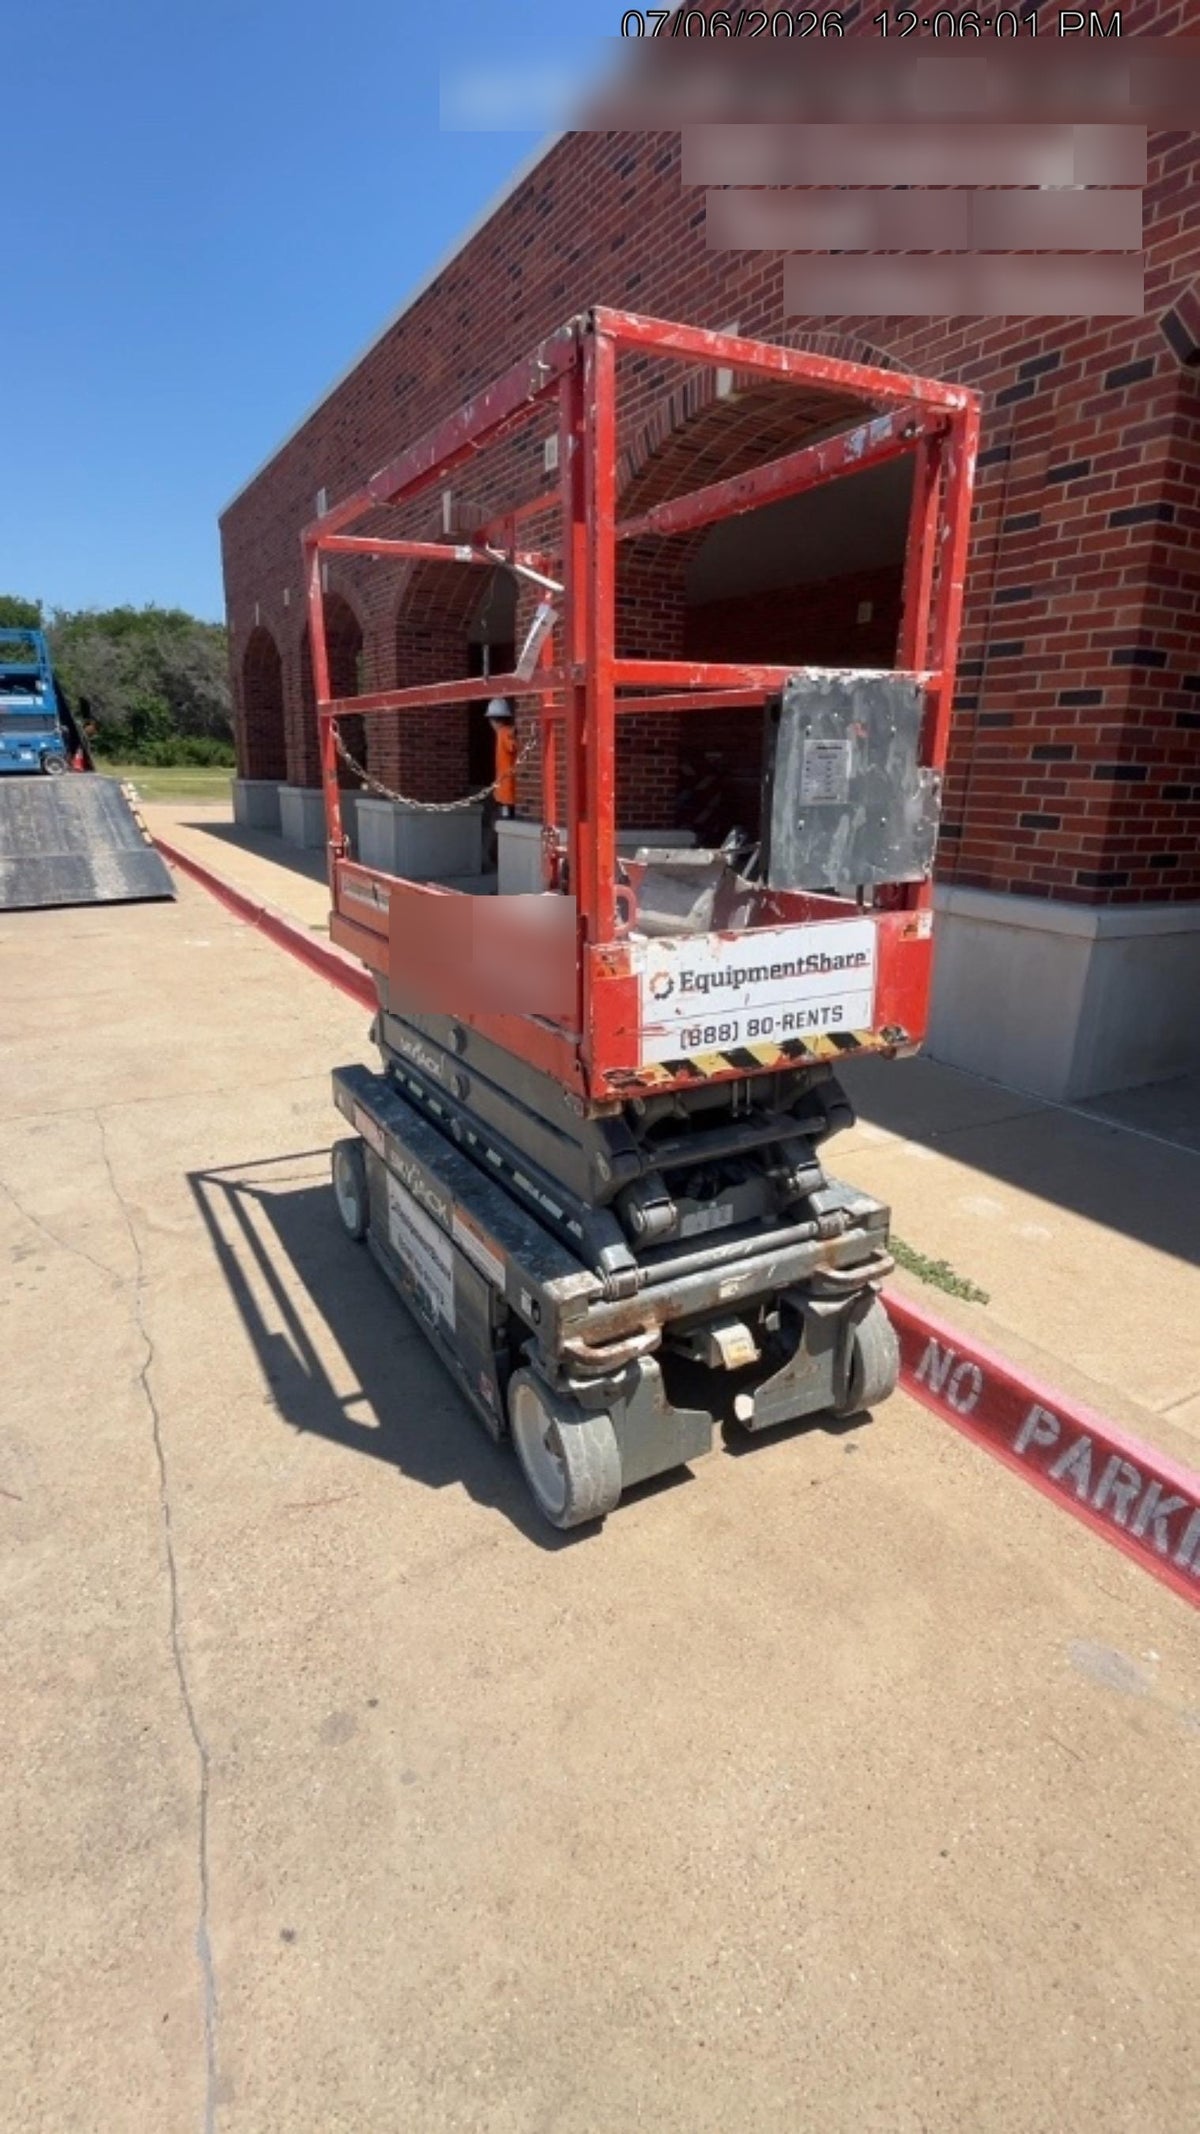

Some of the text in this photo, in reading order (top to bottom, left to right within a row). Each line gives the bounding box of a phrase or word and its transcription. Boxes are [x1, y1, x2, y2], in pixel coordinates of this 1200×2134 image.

[680, 952, 867, 993] EquipmentShare
[680, 1005, 843, 1050] (888) 80-RENTS
[914, 1337, 1200, 1576] NO PARKI
